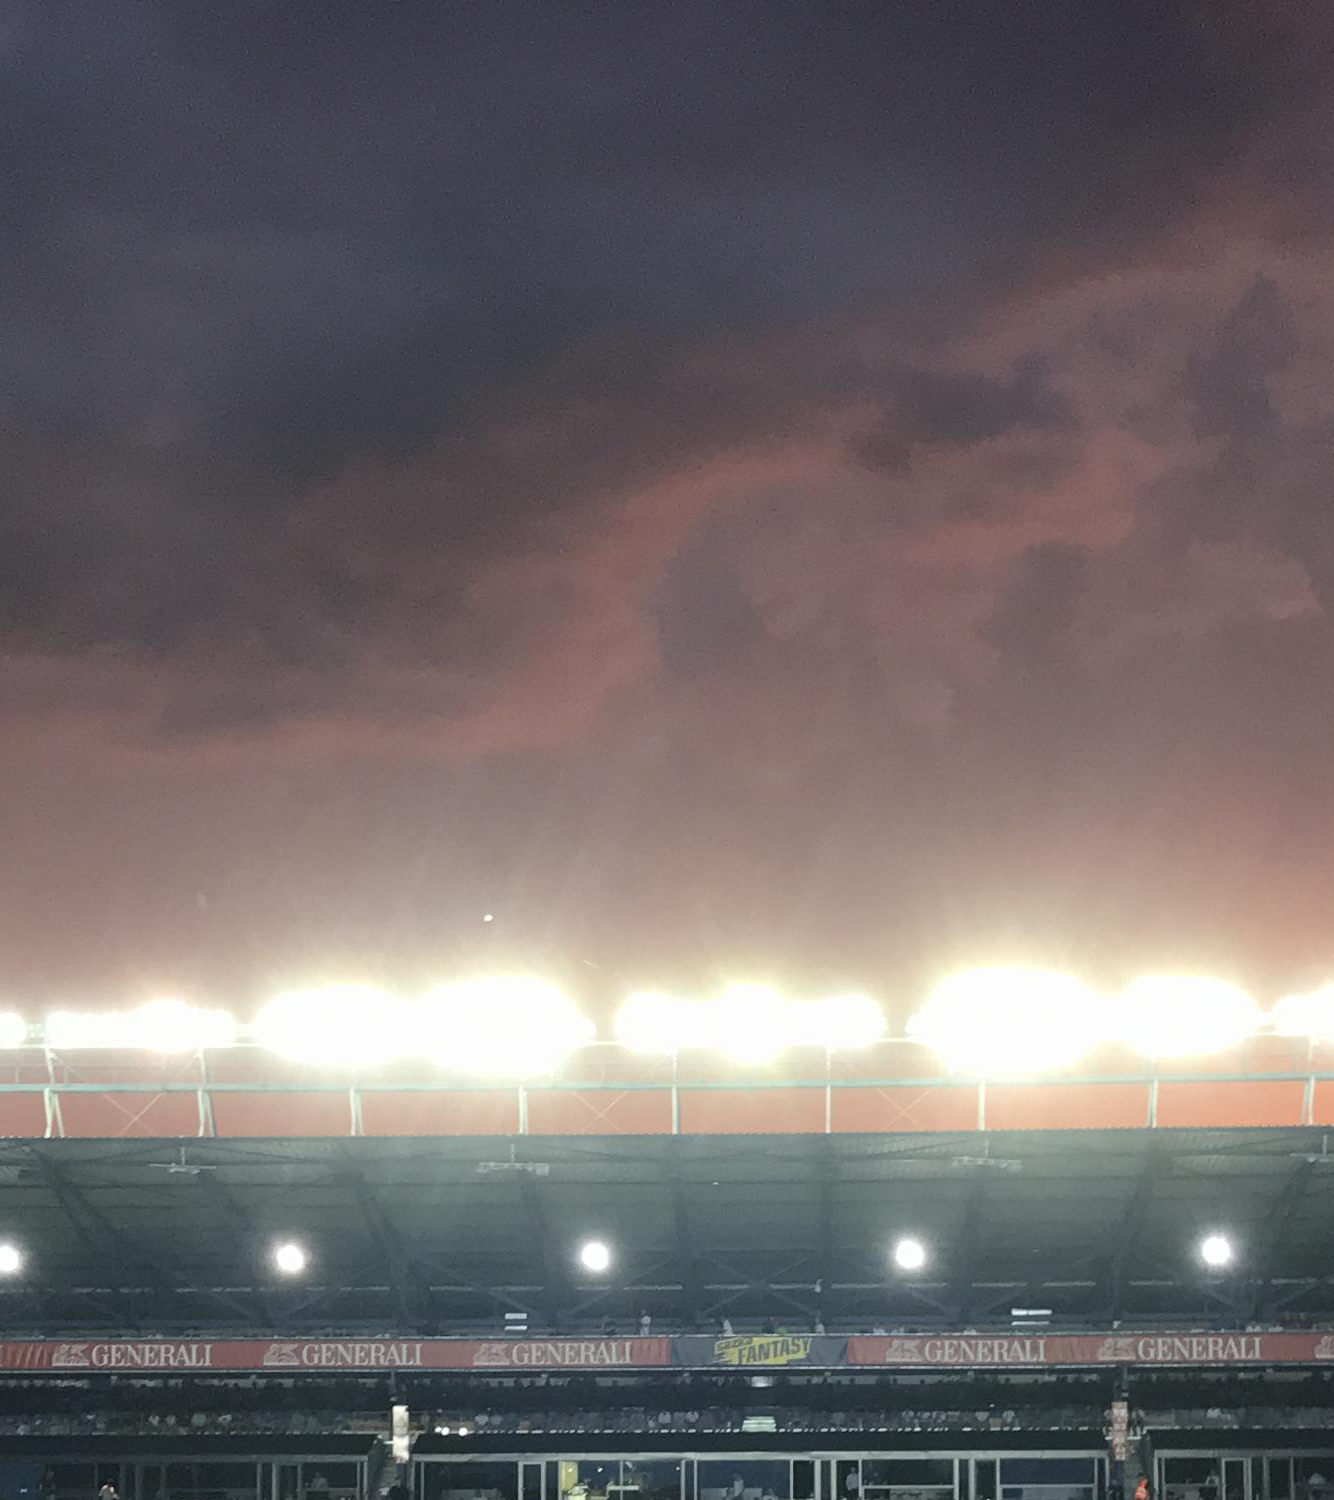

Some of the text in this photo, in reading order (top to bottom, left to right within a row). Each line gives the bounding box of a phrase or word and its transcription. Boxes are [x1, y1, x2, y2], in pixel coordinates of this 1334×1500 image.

[91, 1344, 213, 1367] GENERALI
[301, 1343, 422, 1366] GENERALI
[512, 1343, 632, 1365] GENERALI
[737, 1337, 812, 1365] FANTASY
[925, 1340, 1046, 1362] GENERALI
[1138, 1337, 1261, 1360] GENERALI
